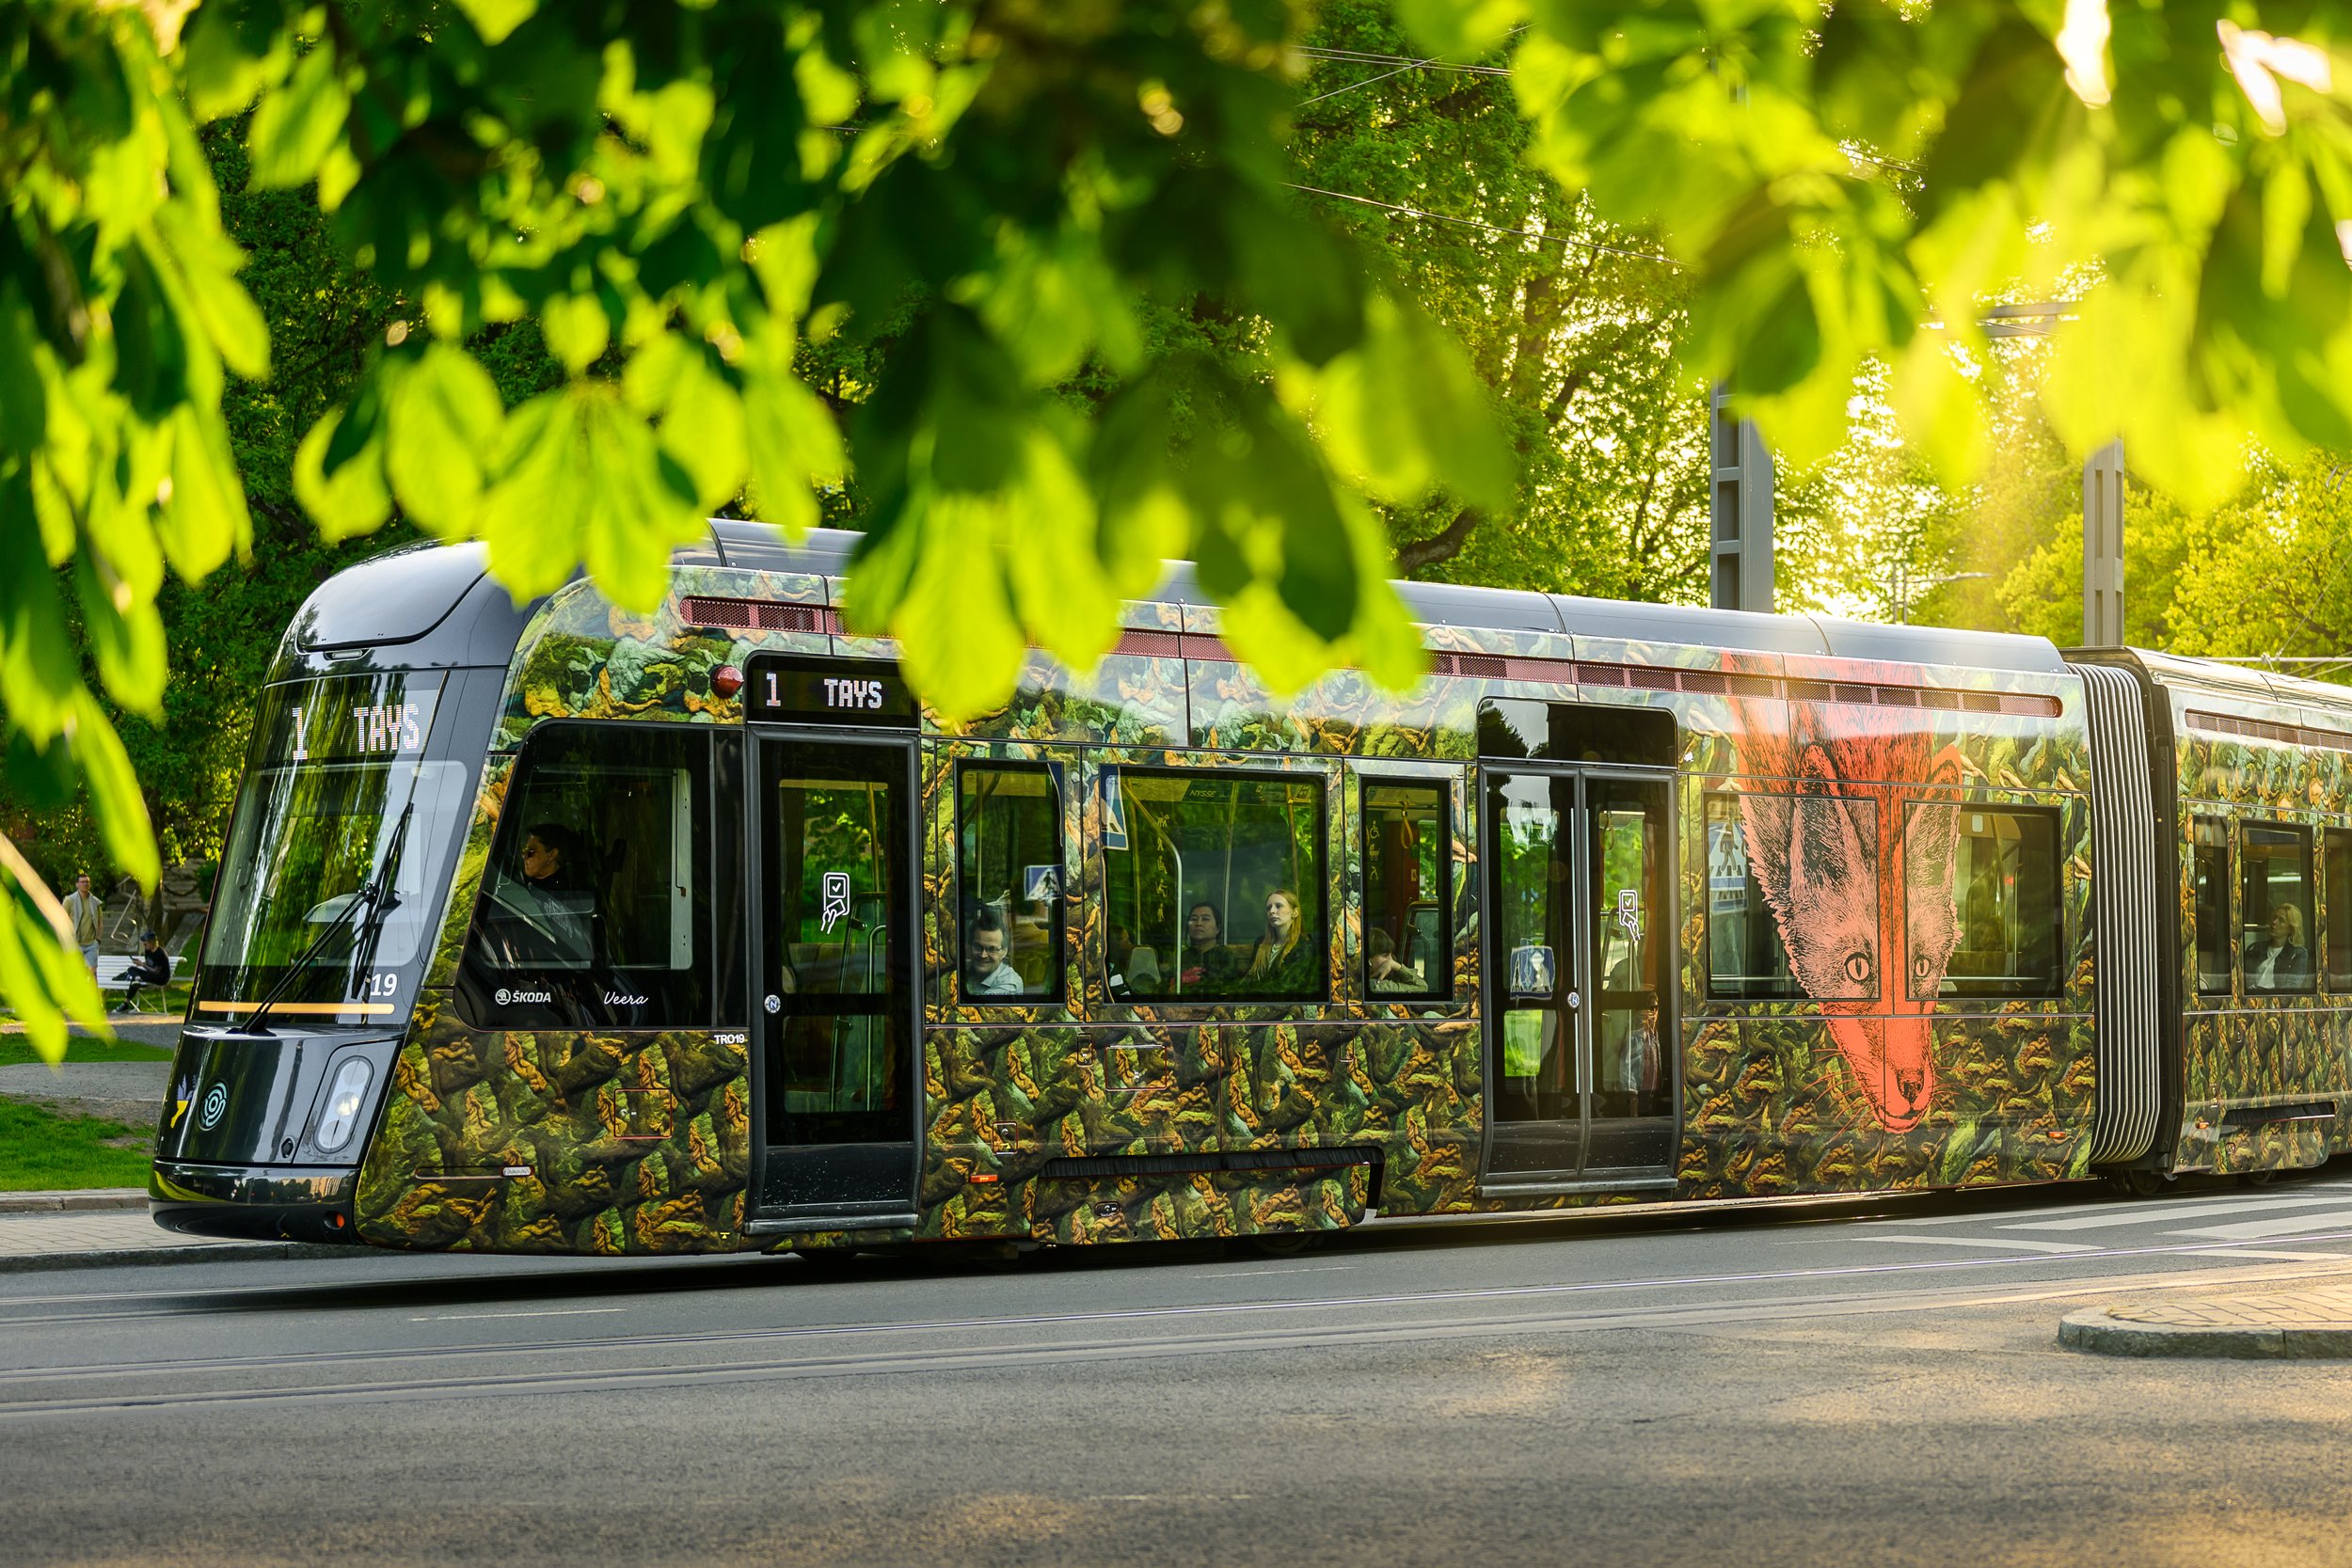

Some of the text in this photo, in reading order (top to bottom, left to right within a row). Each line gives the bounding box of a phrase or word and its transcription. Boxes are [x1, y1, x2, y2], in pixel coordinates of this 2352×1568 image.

[766, 673, 882, 709] 1 TAYS
[293, 704, 420, 760] 1 TAYS
[370, 973, 398, 997] 19
[512, 990, 552, 1003] ŠKODA
[603, 990, 649, 1006] Veera
